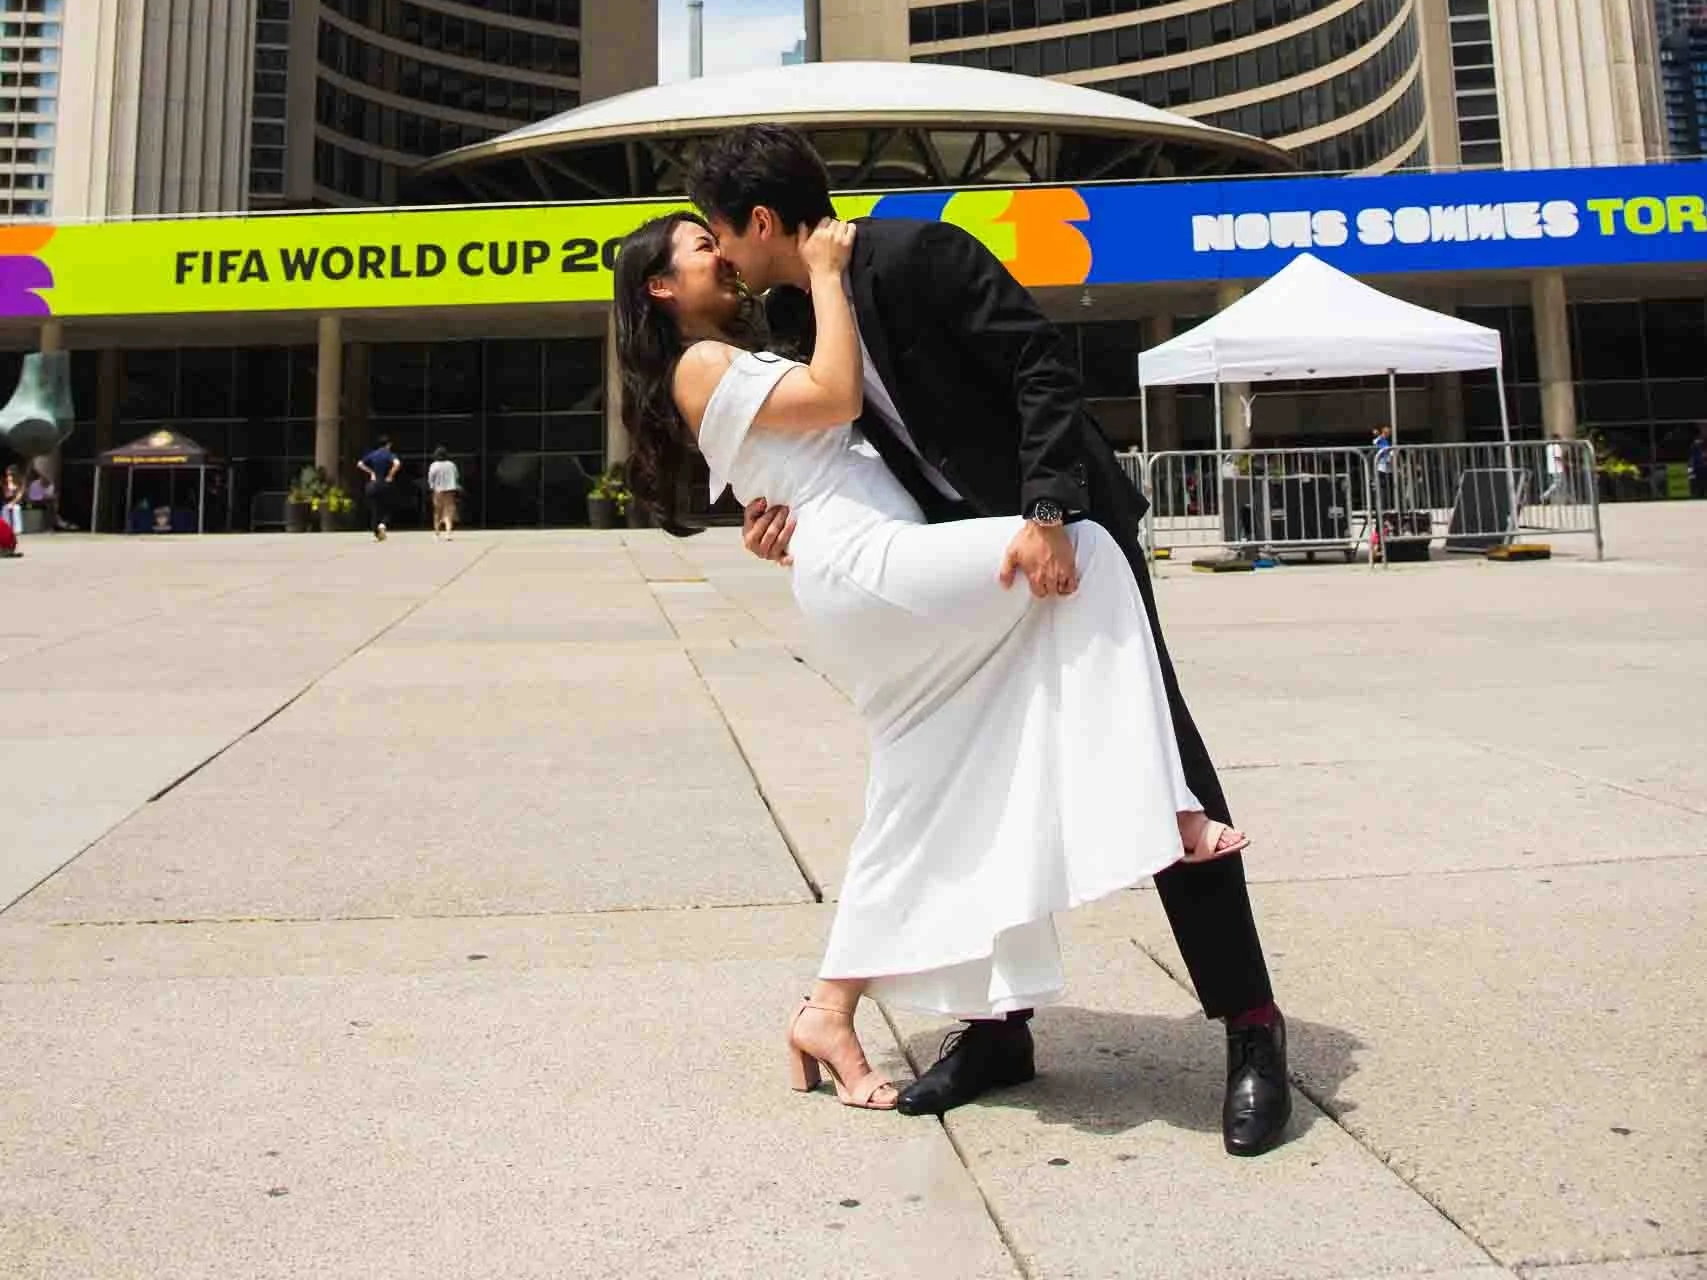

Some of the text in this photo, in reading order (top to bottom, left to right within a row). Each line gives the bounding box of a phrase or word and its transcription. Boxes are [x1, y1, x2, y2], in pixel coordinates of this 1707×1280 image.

[1192, 195, 1707, 252] NOUS SOMMES TOR
[175, 249, 269, 284] FIFA
[279, 243, 447, 281] WORLD
[457, 240, 550, 277] CUP
